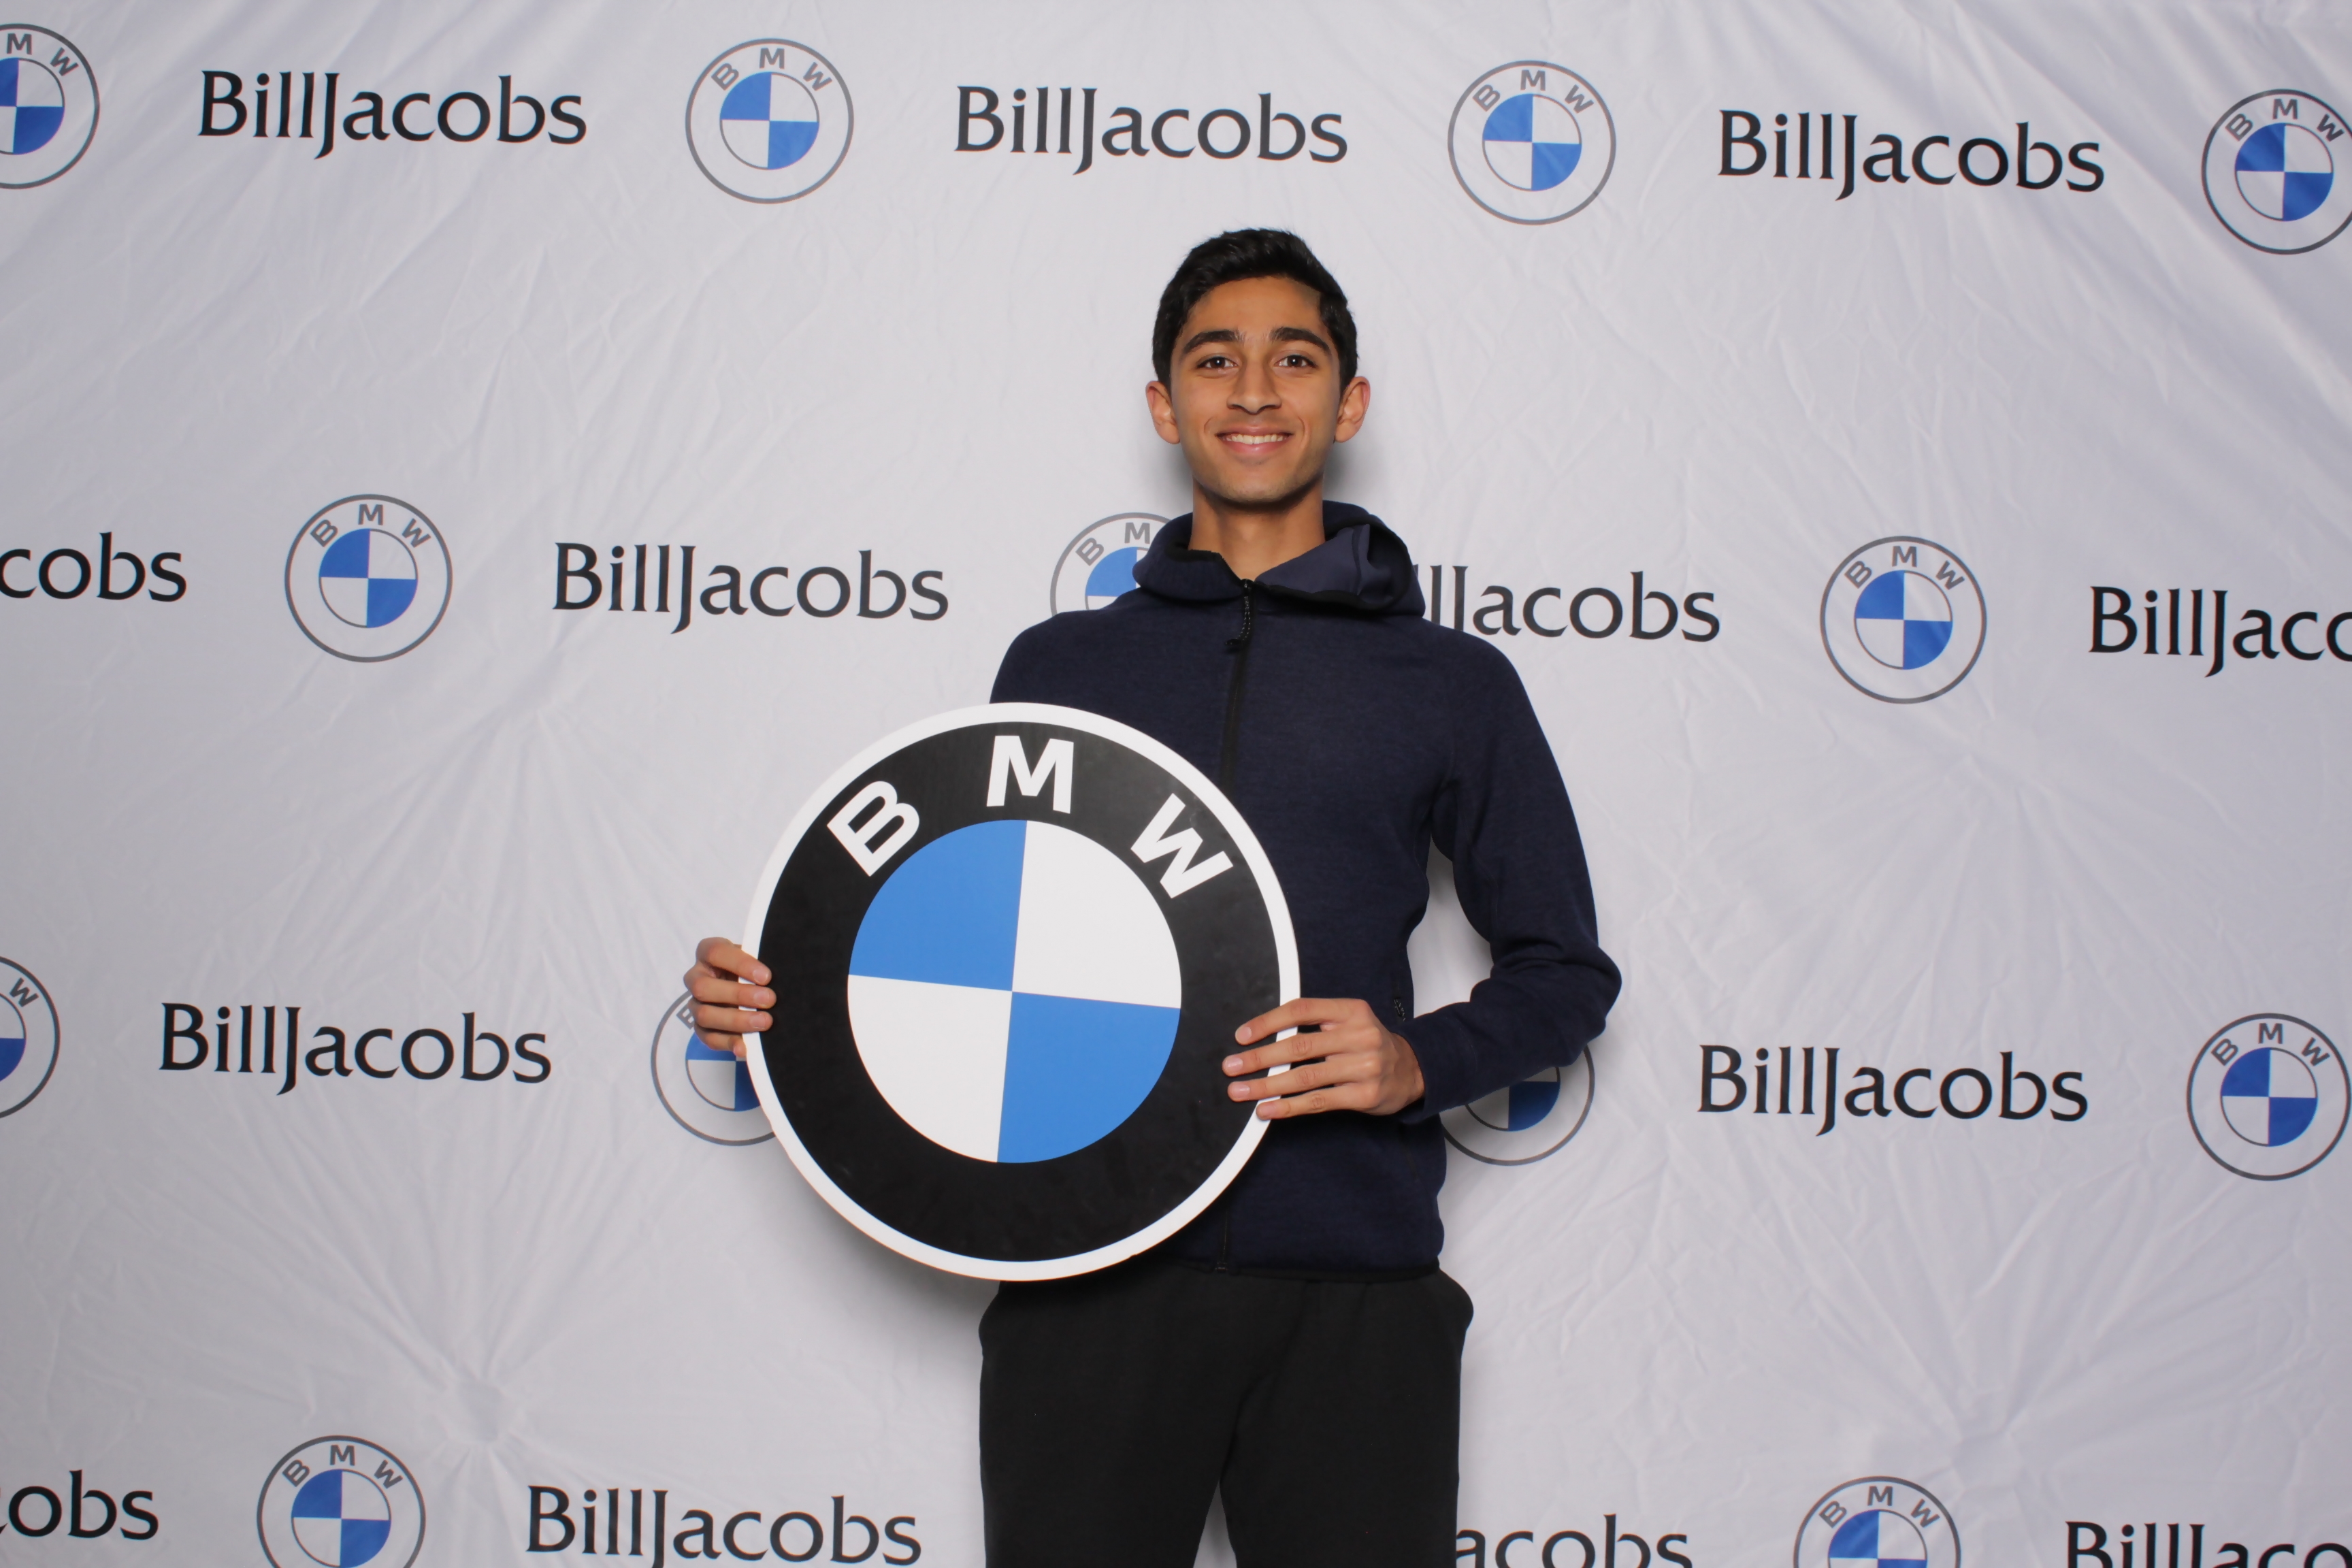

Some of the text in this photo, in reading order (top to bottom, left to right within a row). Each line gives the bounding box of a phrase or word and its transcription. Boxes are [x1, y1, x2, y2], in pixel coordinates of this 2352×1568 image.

[710, 47, 832, 91] BMW
[1472, 69, 1595, 114] BMW
[197, 70, 587, 159] BillJacobs
[956, 86, 1348, 174] BillJacobs
[2225, 99, 2345, 142] BMW
[1718, 110, 2104, 201] BillJacobs
[310, 504, 430, 547] BMW
[1075, 521, 1151, 567] BM
[553, 542, 949, 634] BillJacobs
[1845, 546, 1965, 589] BMW
[826, 734, 1234, 899] BMW
[159, 1002, 551, 1096] BillJacobs
[2210, 1022, 2330, 1066] BMW
[1698, 1045, 2088, 1137] BillJacobs
[282, 1444, 403, 1489] BMW
[0, 1469, 159, 1541] obs
[526, 1485, 921, 1568] BillJacobs
[1819, 1486, 1940, 1528] BMW
